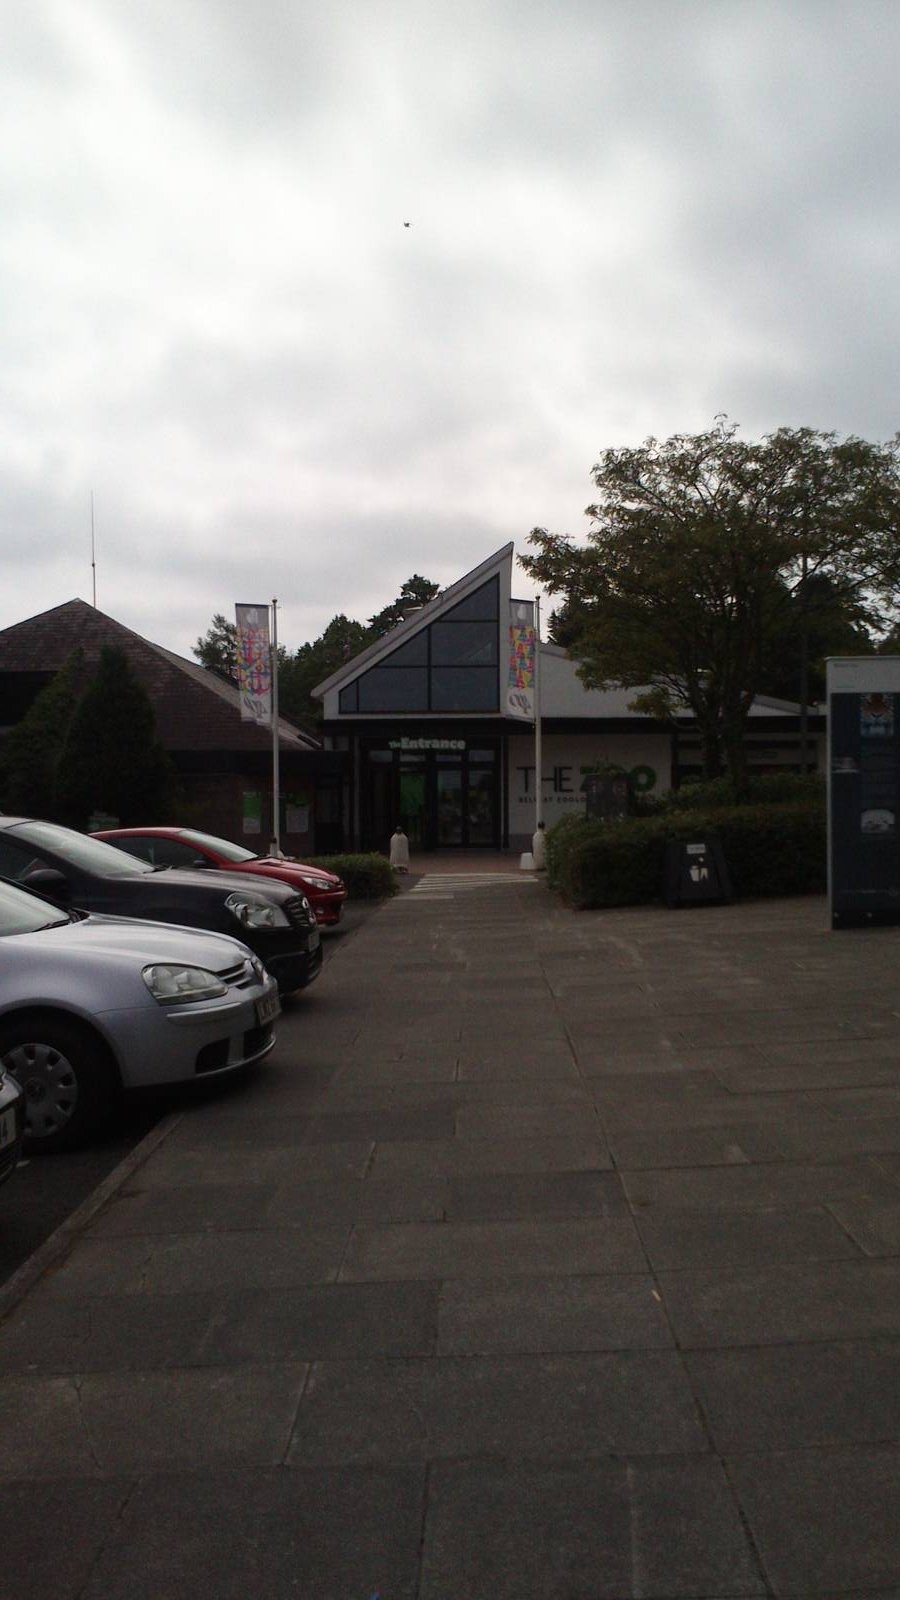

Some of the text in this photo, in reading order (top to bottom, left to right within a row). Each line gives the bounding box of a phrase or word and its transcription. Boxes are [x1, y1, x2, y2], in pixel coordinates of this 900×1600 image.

[401, 736, 466, 750] Entrance
[516, 765, 657, 793] THE ZO
